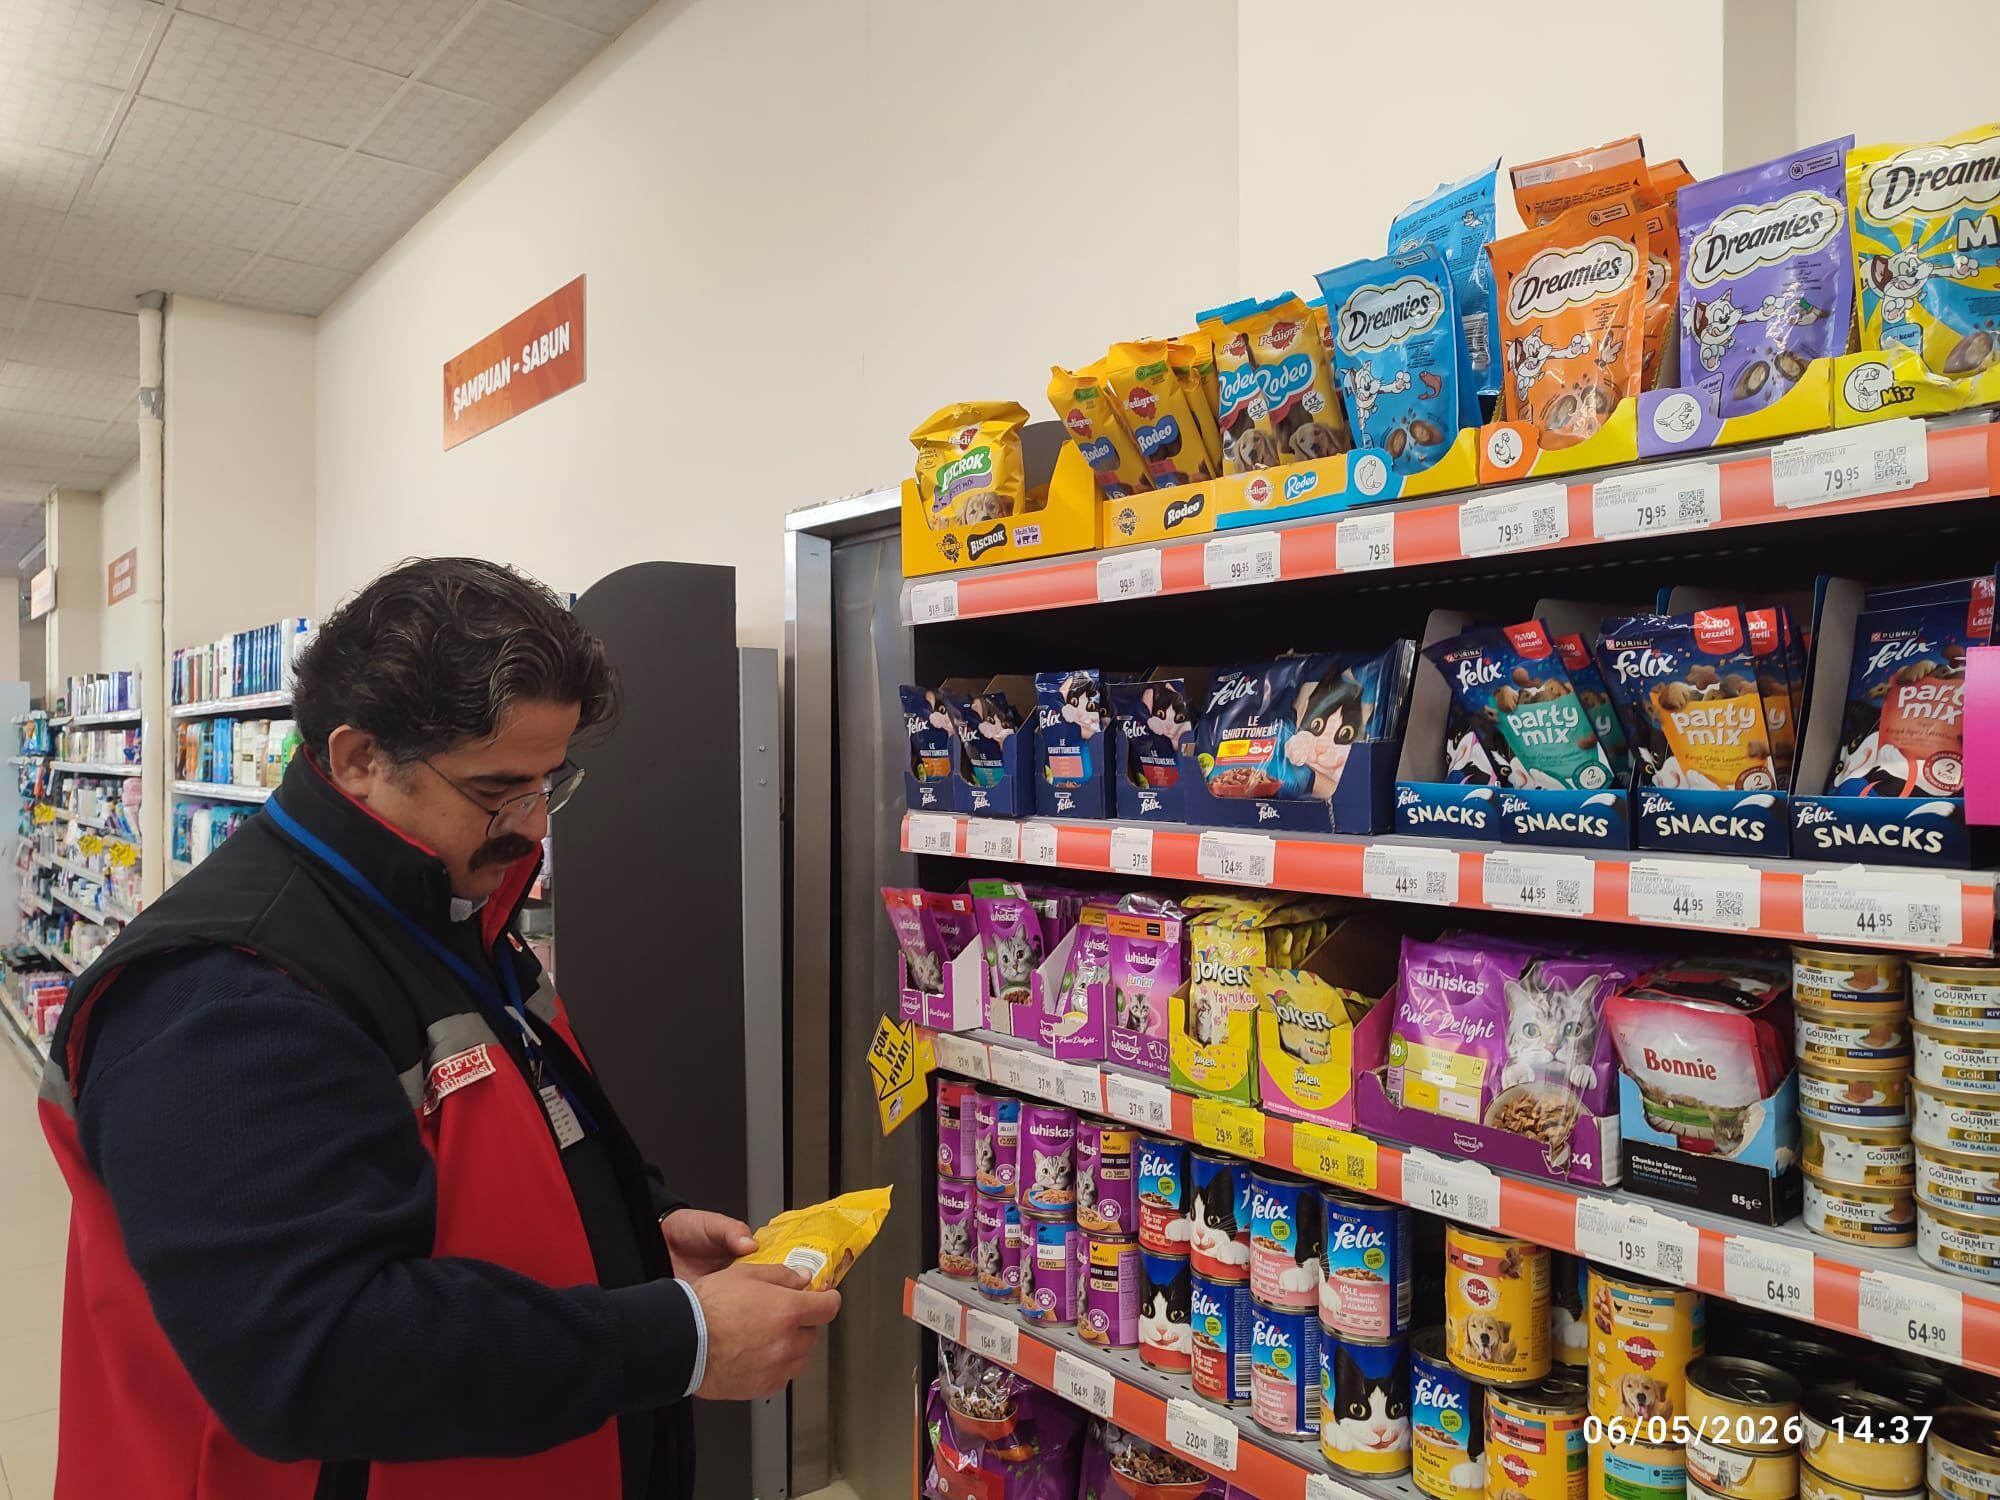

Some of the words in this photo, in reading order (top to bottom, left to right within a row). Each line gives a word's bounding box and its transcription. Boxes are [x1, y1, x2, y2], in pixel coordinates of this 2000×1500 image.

[1705, 209, 1825, 275] Dreamies
[1517, 255, 1624, 311] Dreamies
[1349, 294, 1431, 343] Dreamies
[453, 356, 511, 421] ŞAMPUAN
[521, 321, 570, 375] SABUN
[1256, 361, 1309, 399] Rodeo
[1879, 386, 1915, 406] Mix
[1136, 424, 1173, 453] Rodeo
[1081, 444, 1110, 463] Rodeo
[1286, 473, 1317, 498] Rodeo
[1824, 466, 1860, 492] 79.95
[1166, 500, 1201, 526] Rodeo
[1636, 503, 1667, 528] 79.95
[1028, 526, 1039, 535] Mix
[1497, 521, 1524, 545] 79.95
[970, 529, 1006, 557] BISCROK
[1368, 543, 1391, 562] 79.95
[1230, 561, 1250, 579] 99.95
[1614, 640, 1651, 649] PURINA
[1700, 629, 1735, 640] Lezzetli
[1881, 629, 1919, 640] PURINA
[1612, 650, 1674, 685] felix
[1862, 638, 1938, 680] felix
[1455, 659, 1503, 694] felix
[1206, 676, 1258, 714] felix
[1898, 683, 1966, 708] part
[1039, 705, 1062, 729] felix
[1248, 716, 1260, 727] LE
[1506, 703, 1579, 736] party
[1671, 703, 1757, 736] party
[1902, 699, 1963, 726] mix
[907, 717, 930, 737] felix
[1122, 720, 1149, 739] felix
[1523, 725, 1570, 748] mix
[1687, 726, 1744, 747] mix
[1587, 769, 1596, 780] 2
[1945, 762, 1956, 776] 2
[1753, 775, 1763, 787] 2
[1056, 798, 1076, 814] felix
[1140, 799, 1162, 815] felix
[1397, 790, 1422, 808] felix
[1501, 798, 1530, 817] felix
[1643, 797, 1675, 818] felix
[1258, 806, 1281, 823] felix
[1407, 805, 1487, 830] SNACKS
[1796, 806, 1834, 829] felix
[1514, 812, 1609, 838] SNACKS
[1655, 815, 1766, 842] SNACKS
[1813, 823, 1945, 854] SNACKS
[1220, 859, 1243, 876] 124.95
[1395, 877, 1418, 894] 44.95
[1520, 886, 1546, 904] 44.95
[1672, 896, 1704, 916] 44.95
[990, 910, 1019, 923] whiskas
[1856, 911, 1894, 932] 44.95
[1124, 951, 1161, 967] whiskas
[1126, 974, 1155, 989] junior
[1418, 969, 1486, 996] whiskas
[1797, 968, 1835, 985] GOURMET
[1213, 989, 1238, 1005] Yavru
[1803, 986, 1823, 998] Gold
[1934, 988, 1988, 1002] GOURMET
[1936, 1017, 1951, 1025] TON
[1946, 1006, 1973, 1018] Gold
[1400, 1003, 1432, 1027] Pure
[1439, 1013, 1496, 1044] Delight
[874, 1026, 890, 1059] ÇOK
[1805, 1027, 1850, 1043] GOURMET
[885, 1040, 899, 1065] İYİ
[1814, 1044, 1837, 1056] Gold
[1944, 1050, 2000, 1065] GOURMET
[889, 1039, 912, 1087] FİYATI
[1643, 1047, 1718, 1082] Bonnie
[1945, 1080, 1961, 1088] TON
[1957, 1069, 1985, 1081] Gold
[1829, 1103, 1861, 1114] KIYILMIŞ
[1950, 1111, 2000, 1128] GOURME
[1030, 1123, 1075, 1139] whiskas
[1215, 1127, 1233, 1143] 29.95
[1963, 1130, 1993, 1143] Gold
[1951, 1140, 1968, 1149] TON
[1139, 1154, 1175, 1178] felix
[1319, 1154, 1340, 1172] 29.95
[1571, 1153, 1593, 1169] x4
[1632, 1162, 1643, 1171] Sos
[1867, 1151, 1912, 1163] GOURMET
[1663, 1161, 1683, 1174] Gravy
[1928, 1166, 1978, 1186] GOURMET
[1429, 1189, 1459, 1209] 124.95
[1930, 1194, 1944, 1205] TON
[1938, 1186, 1963, 1200] Gold
[1251, 1194, 1291, 1220] felix
[1826, 1200, 1876, 1218] GOURMET
[1837, 1218, 1862, 1231] Gold
[1333, 1223, 1386, 1253] felix
[1941, 1231, 1996, 1251] GOURMET
[1618, 1239, 1646, 1261] 19.95
[1952, 1251, 1980, 1265] Gold
[1940, 1258, 1956, 1270] TON
[1628, 1294, 1654, 1305] ADULT
[1767, 1279, 1801, 1303] 64.90
[1191, 1289, 1222, 1318] felix
[1252, 1320, 1293, 1350] felix
[1908, 1319, 1947, 1344] 64.90
[1616, 1338, 1665, 1358] Pedigree
[1414, 1378, 1463, 1410] felix
[1497, 1454, 1537, 1478] Pedigree
[1941, 1461, 1992, 1488] GOURMET
